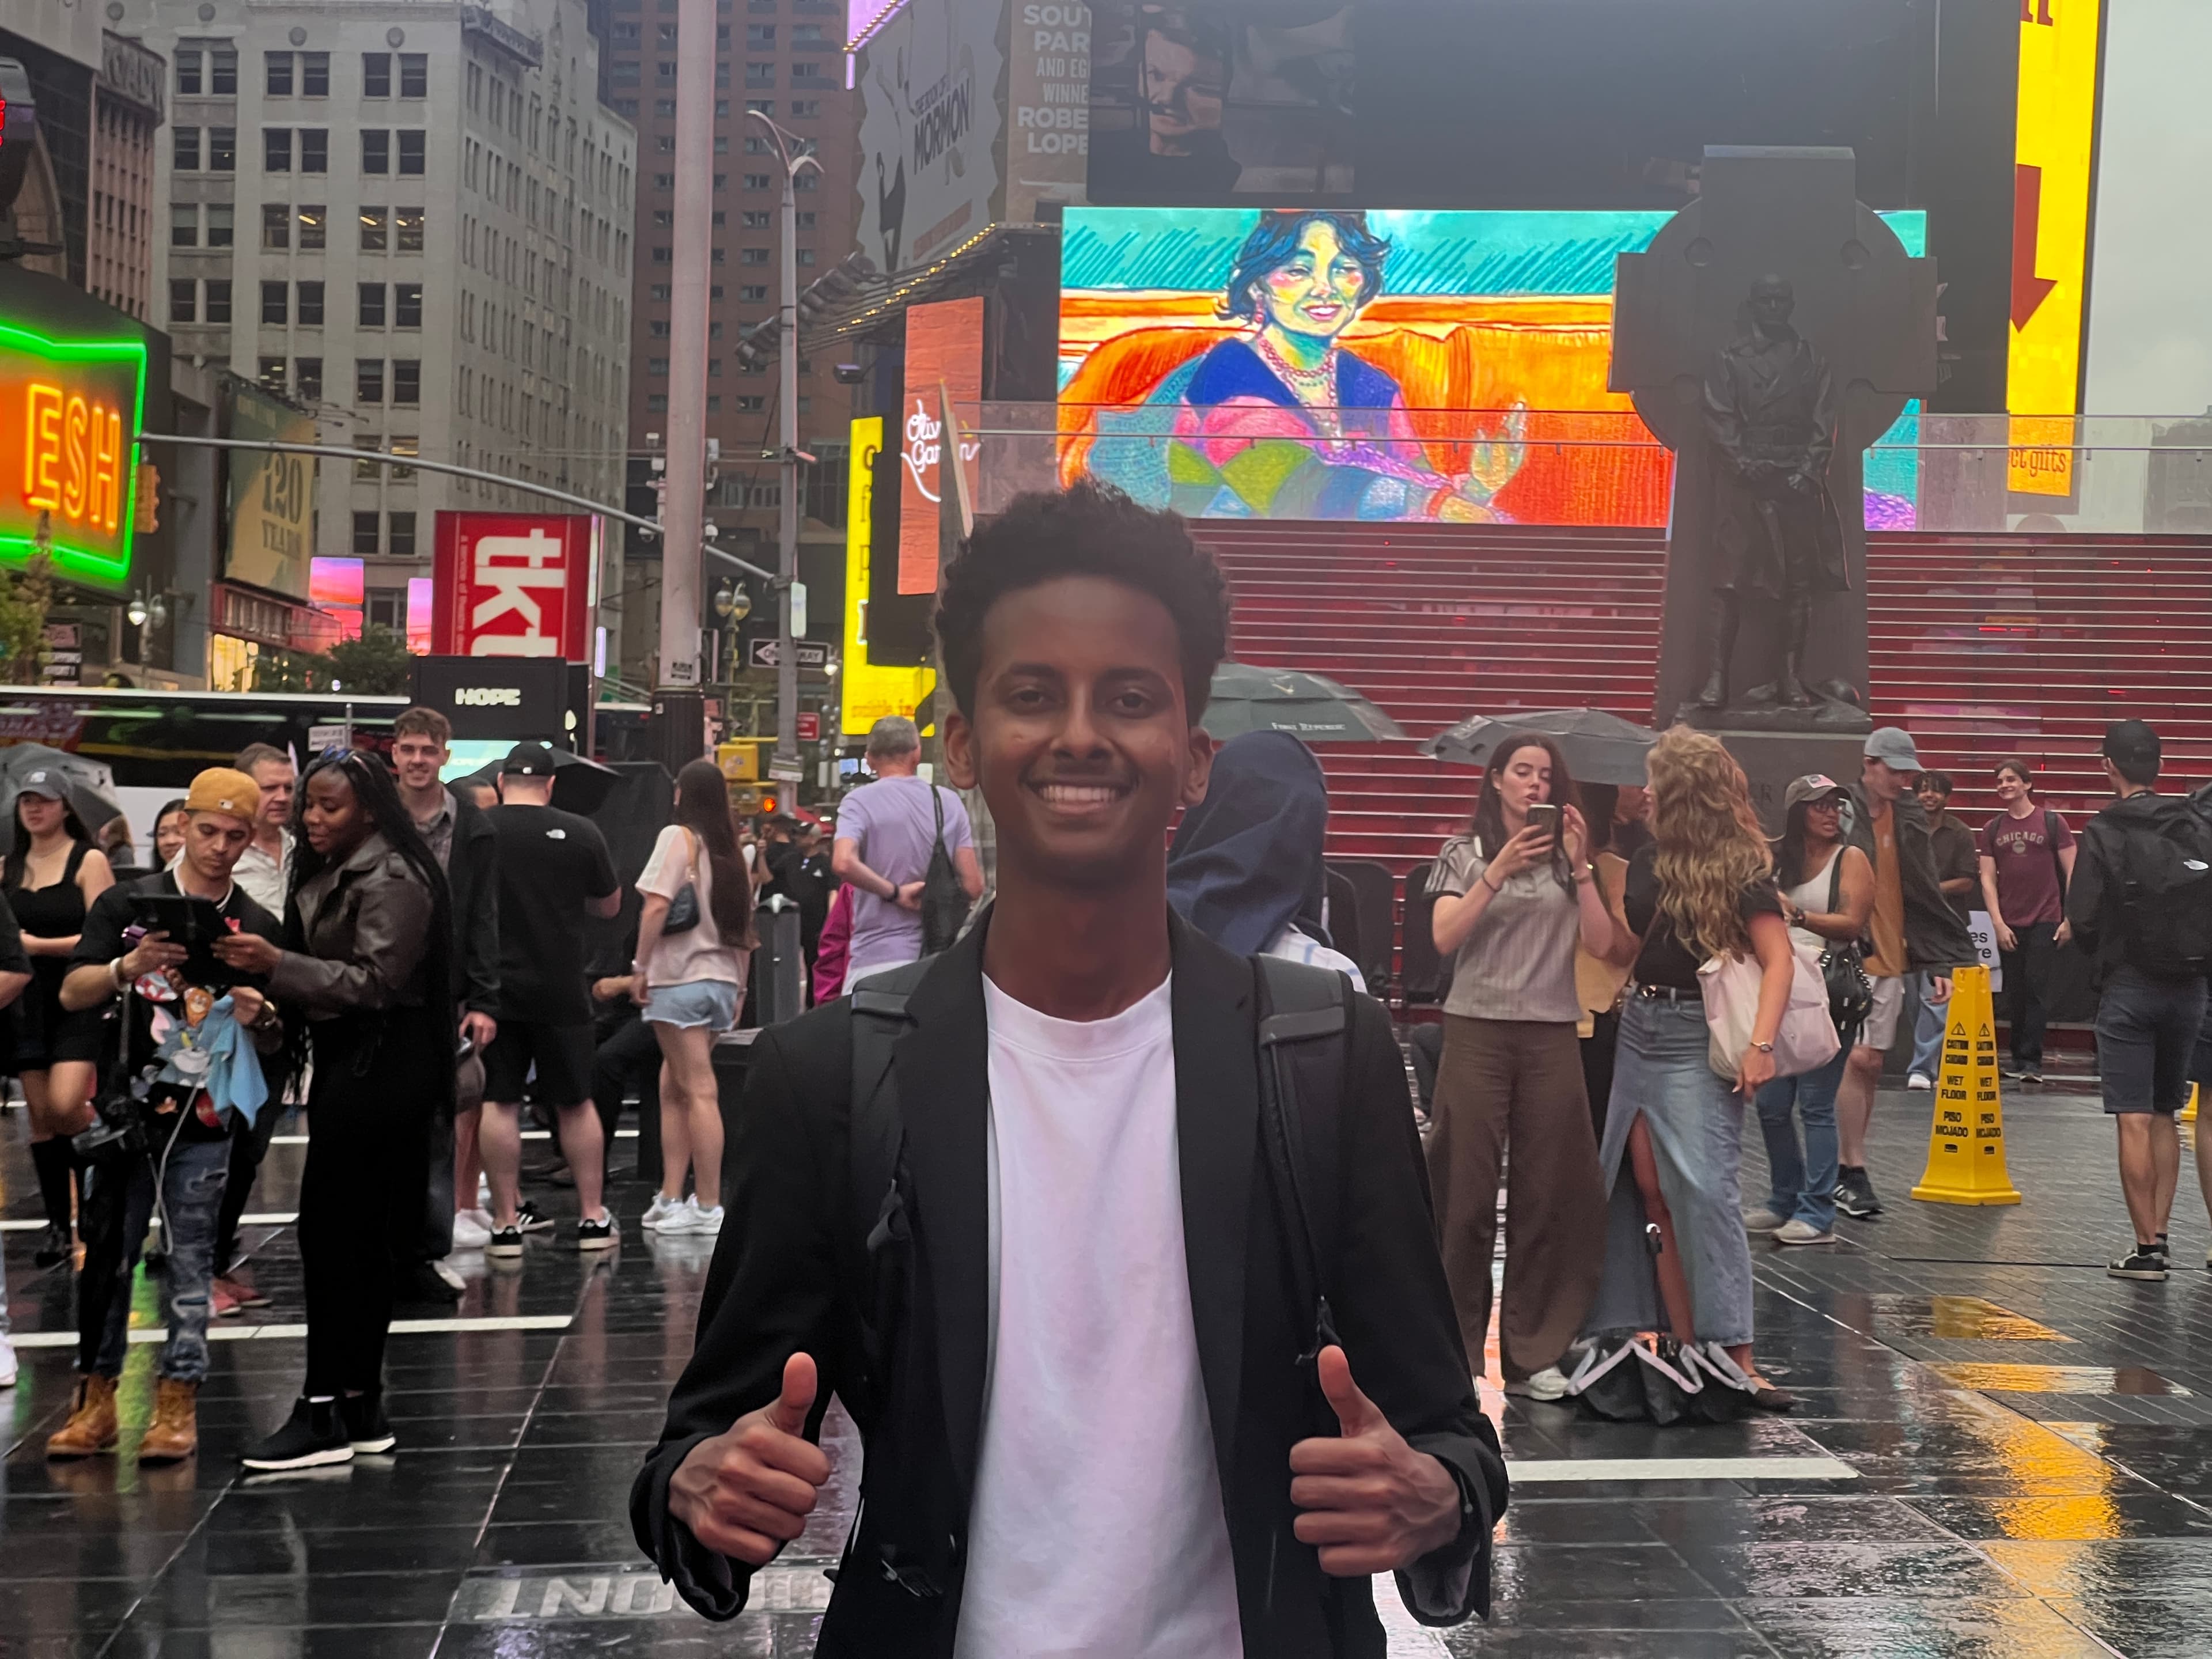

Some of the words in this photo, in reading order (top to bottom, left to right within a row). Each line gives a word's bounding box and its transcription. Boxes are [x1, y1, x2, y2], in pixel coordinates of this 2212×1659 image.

[1036, 57, 1065, 77] AND
[1070, 58, 1090, 79] EG
[914, 77, 970, 176] MORMON
[906, 399, 942, 442] Oliv
[25, 382, 121, 528] ESH
[2029, 444, 2067, 478] gifts
[455, 688, 521, 706] HOPE
[1996, 831, 2045, 847] CHICAGO
[1946, 1075, 1964, 1086] WET
[1979, 1077, 1993, 1087] WET
[1941, 1089, 1967, 1101] FLOOR
[1977, 1091, 1997, 1101] FLOOR
[1943, 1111, 1962, 1123] PISO
[1980, 1113, 1994, 1124] PISO
[1936, 1124, 1968, 1138] MOJADO
[1976, 1127, 2001, 1138] MOJADO
